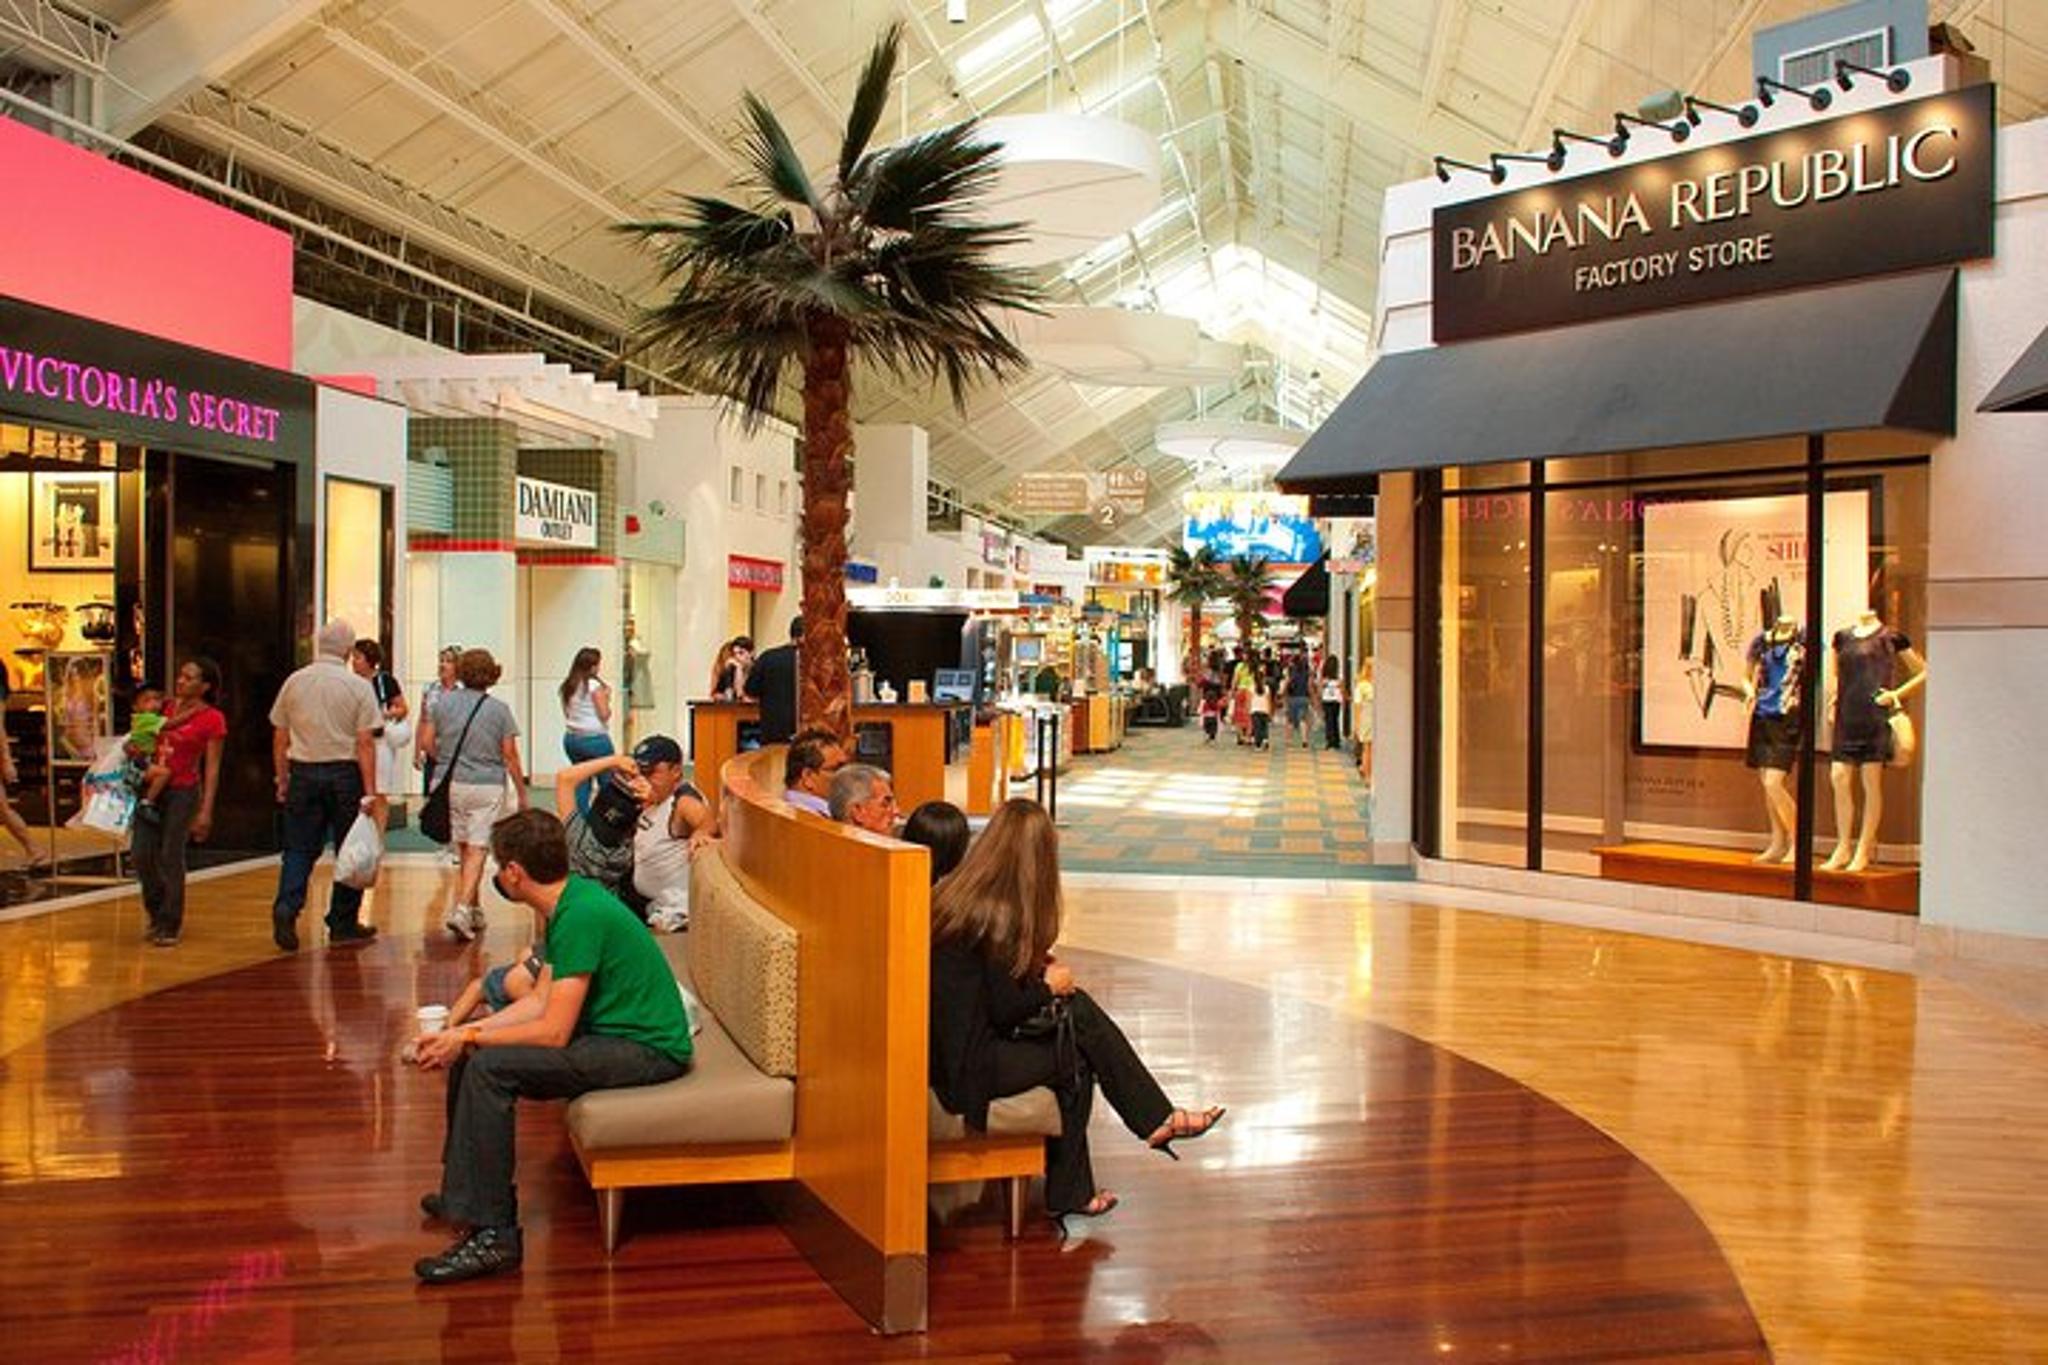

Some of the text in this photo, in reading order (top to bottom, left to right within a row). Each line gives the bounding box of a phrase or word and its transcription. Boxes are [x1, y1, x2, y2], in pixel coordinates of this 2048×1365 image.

[1451, 127, 1958, 270] BANANA REPUBLIC
[1574, 232, 1774, 293] FACTORY STORE
[0, 346, 281, 442] VICTORIA'S SECRET
[519, 481, 593, 527] DAMIANI
[1100, 505, 1114, 525] 2
